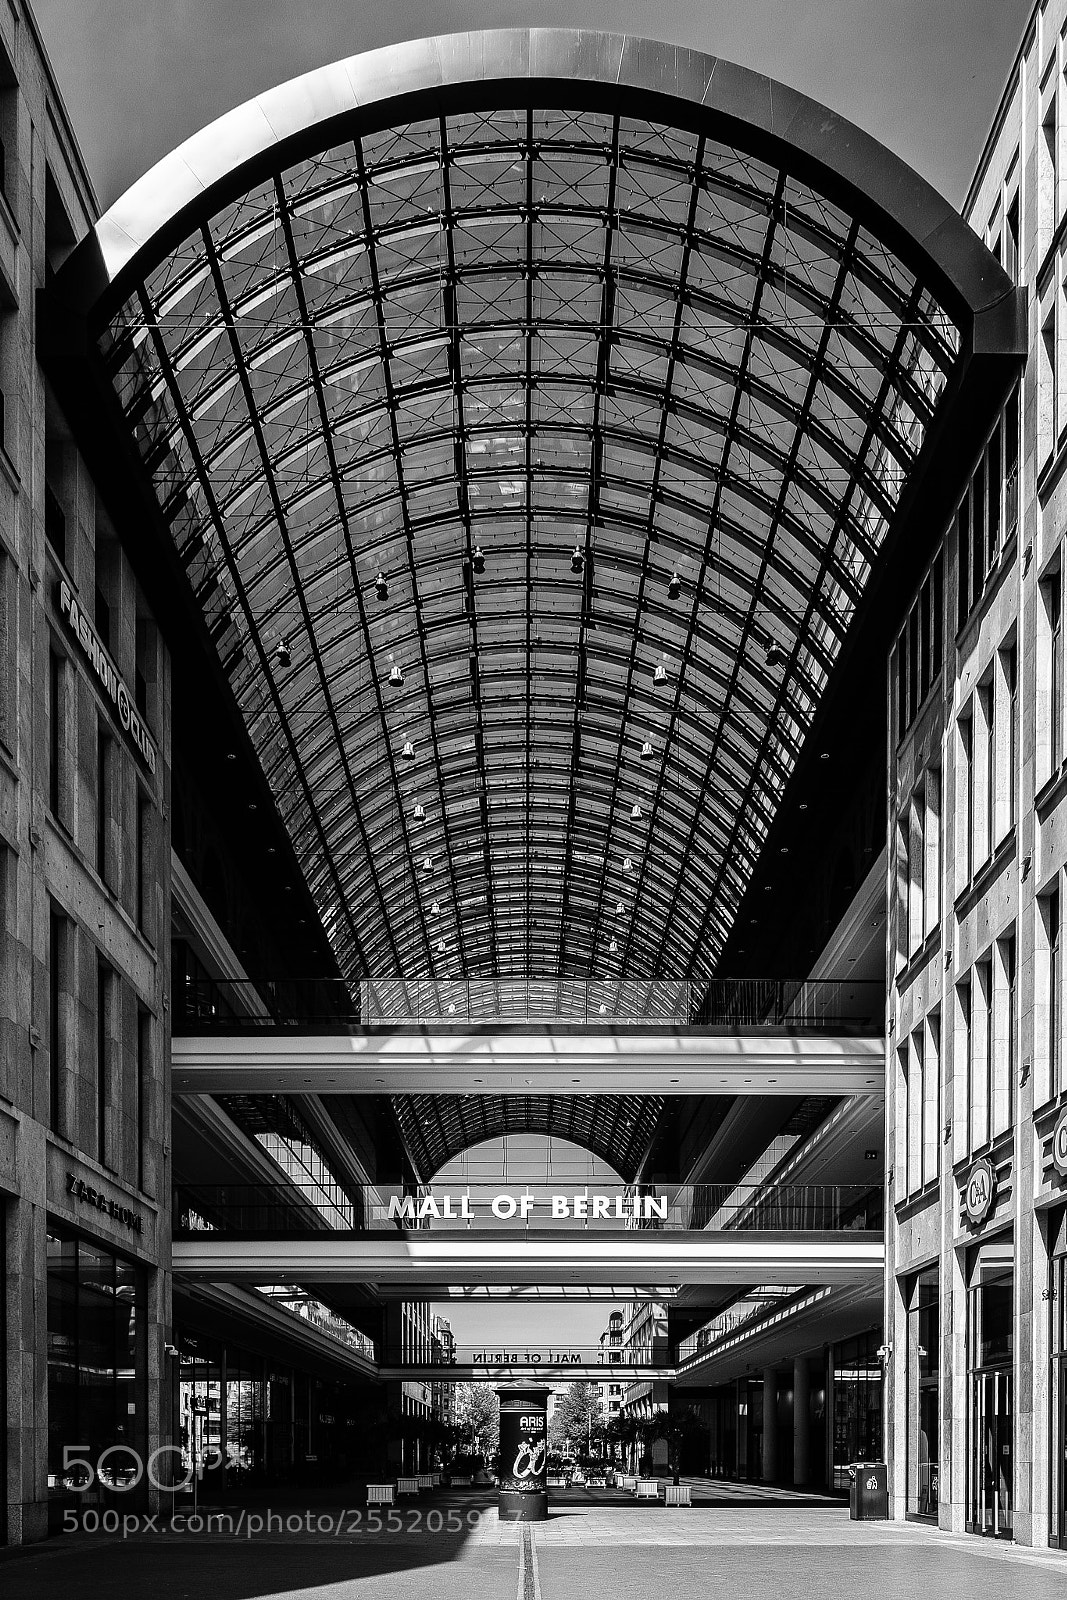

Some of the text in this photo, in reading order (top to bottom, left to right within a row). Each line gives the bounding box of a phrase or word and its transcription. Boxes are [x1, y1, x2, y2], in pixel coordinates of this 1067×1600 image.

[60, 580, 156, 775] FASHION CLUB
[67, 1172, 145, 1235] ZARA HOME
[387, 1194, 668, 1220] MALL OF BERLIN
[970, 1174, 988, 1208] C&A
